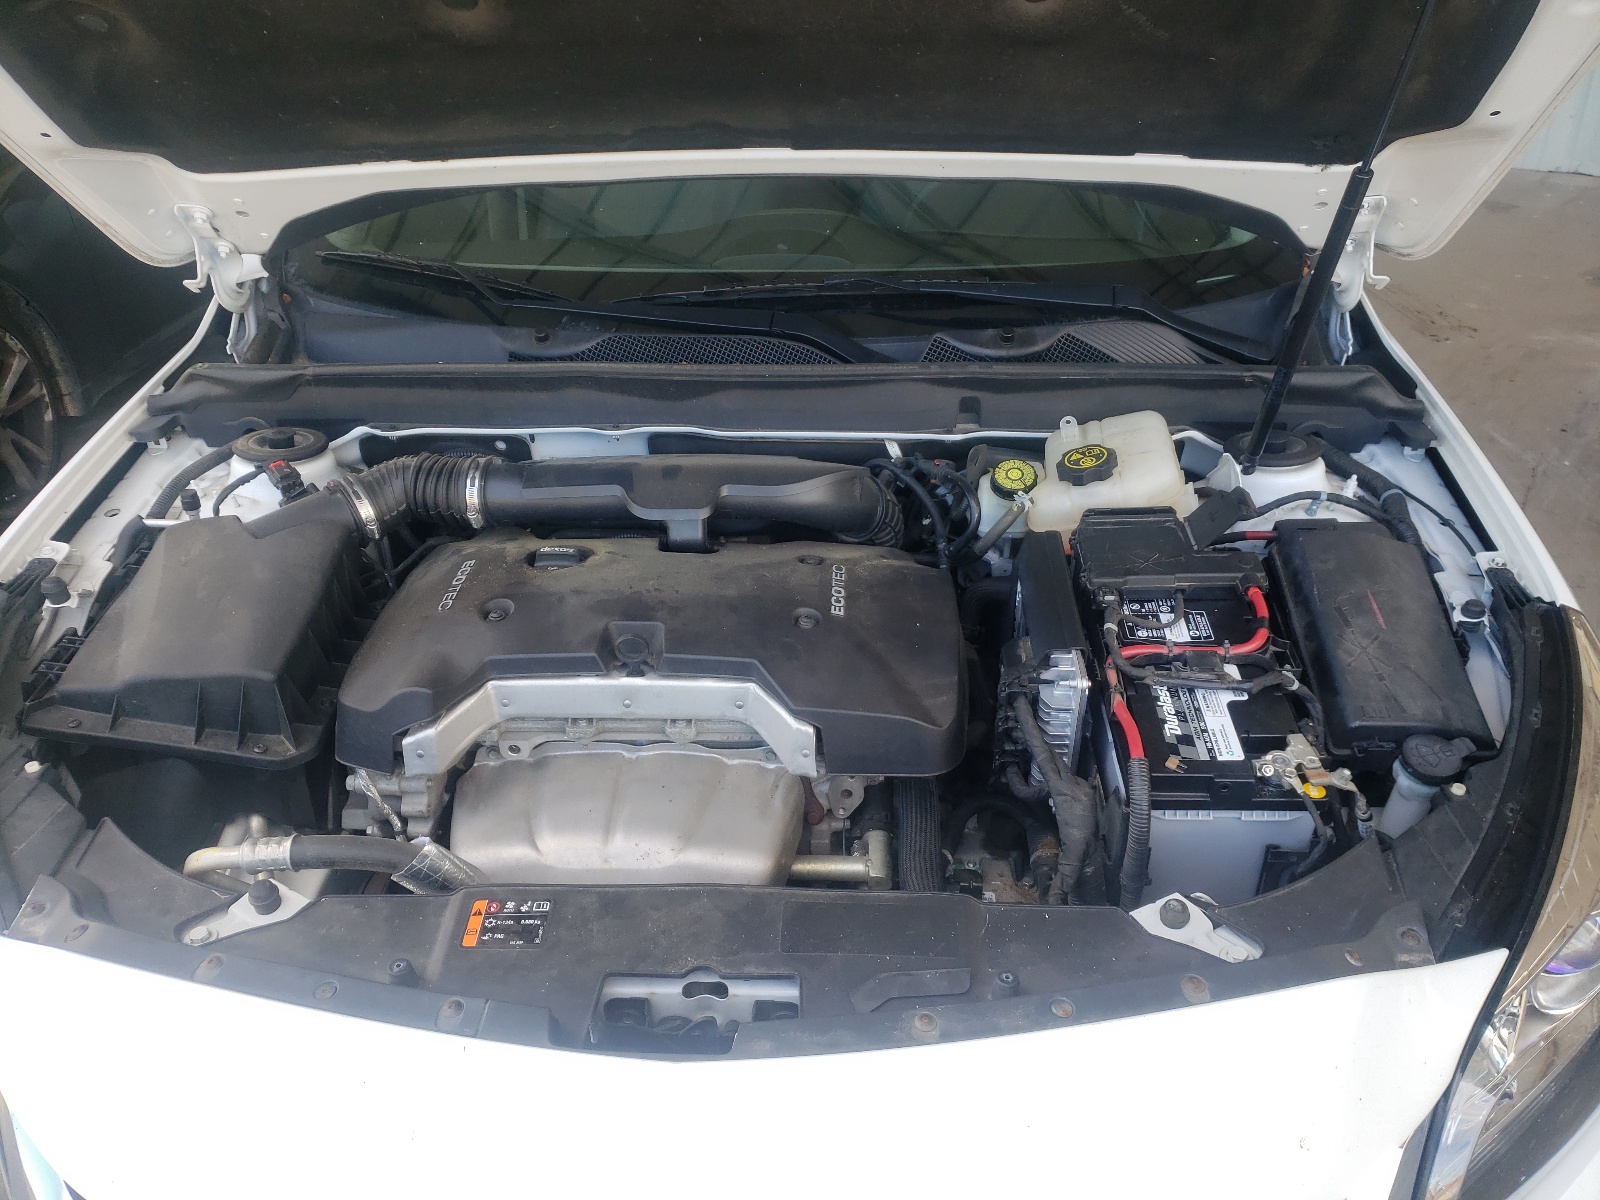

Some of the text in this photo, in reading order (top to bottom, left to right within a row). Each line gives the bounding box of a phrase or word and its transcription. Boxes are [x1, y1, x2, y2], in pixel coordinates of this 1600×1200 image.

[438, 559, 476, 612] ECOTEC
[830, 564, 845, 617] ECOTEC
[1152, 685, 1182, 736] Duralast
[1192, 726, 1201, 740] AGM
